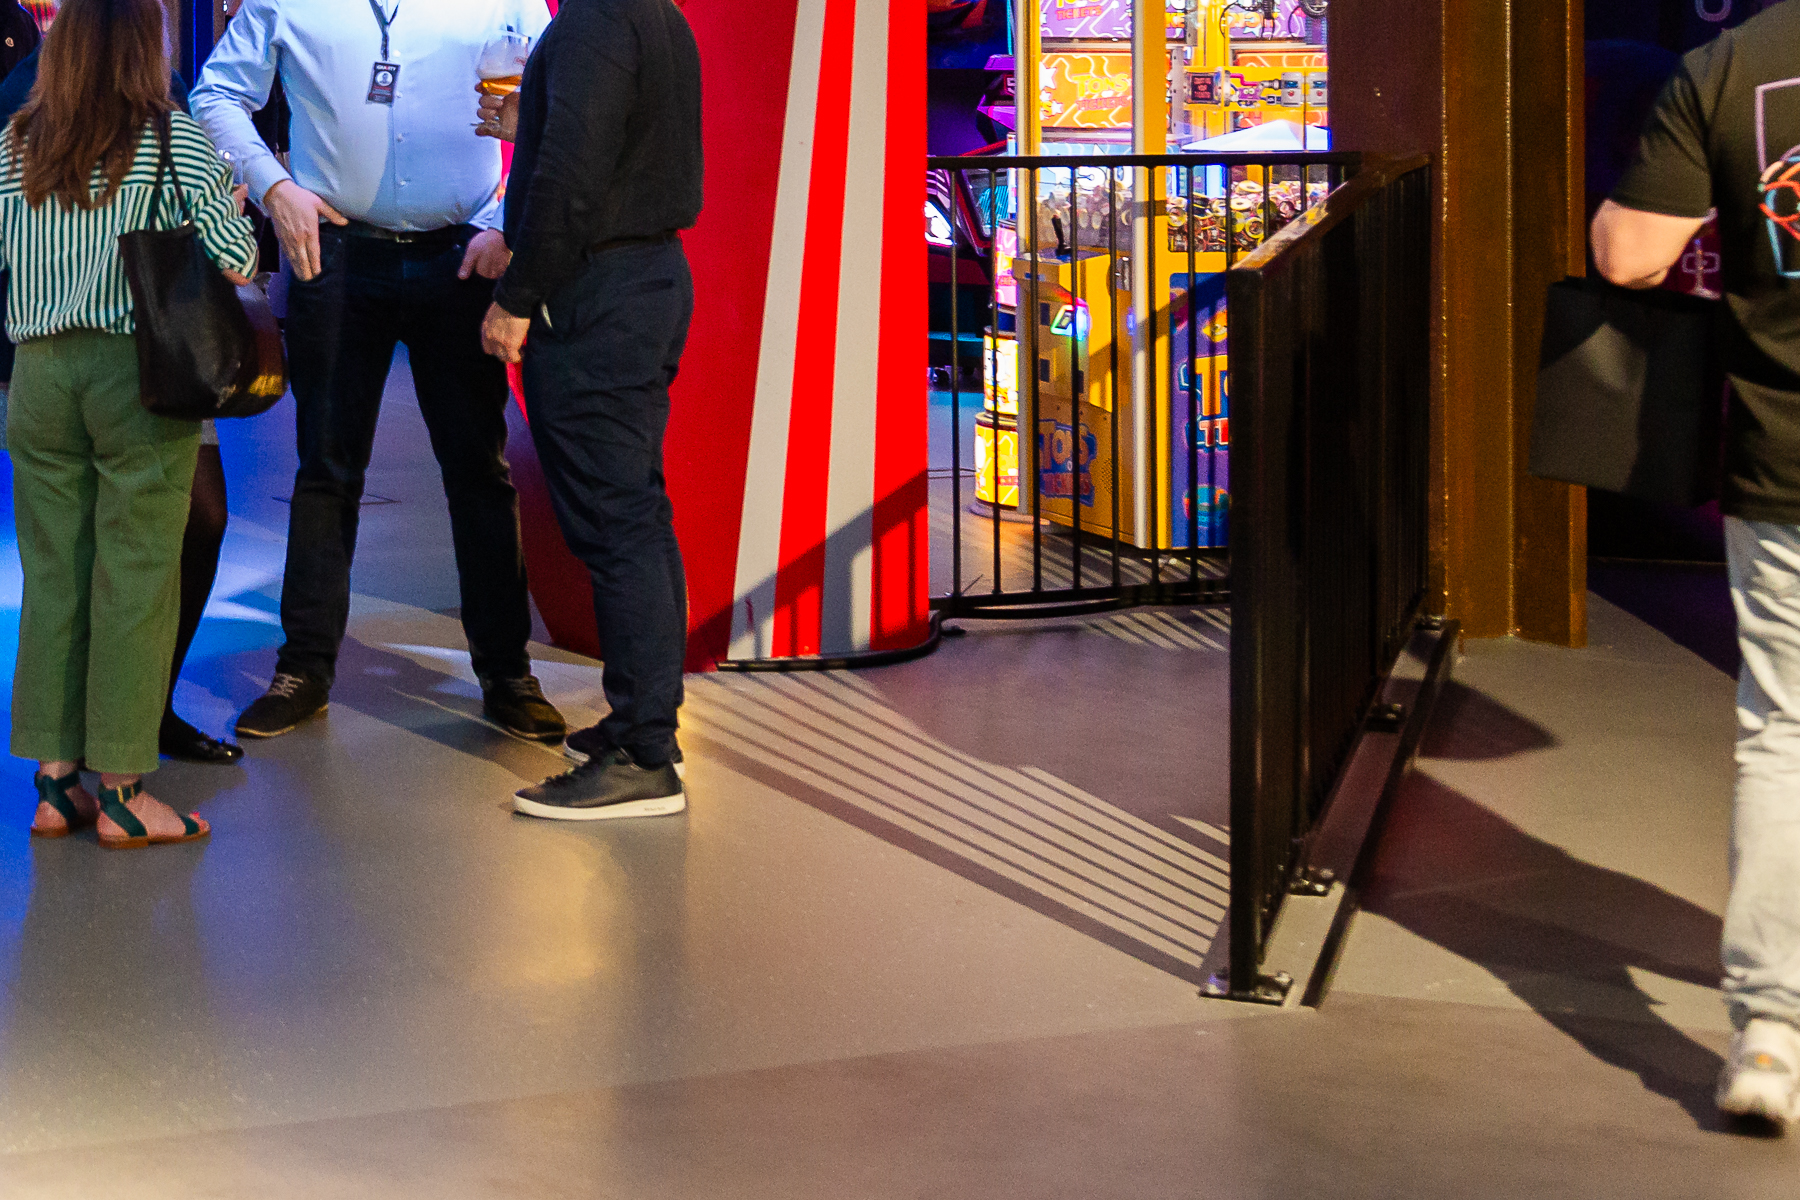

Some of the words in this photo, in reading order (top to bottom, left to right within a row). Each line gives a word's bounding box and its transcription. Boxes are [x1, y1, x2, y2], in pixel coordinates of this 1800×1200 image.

[1054, 5, 1103, 21] TICKETS
[1072, 72, 1129, 98] TONS
[1076, 95, 1132, 111] TICKETS
